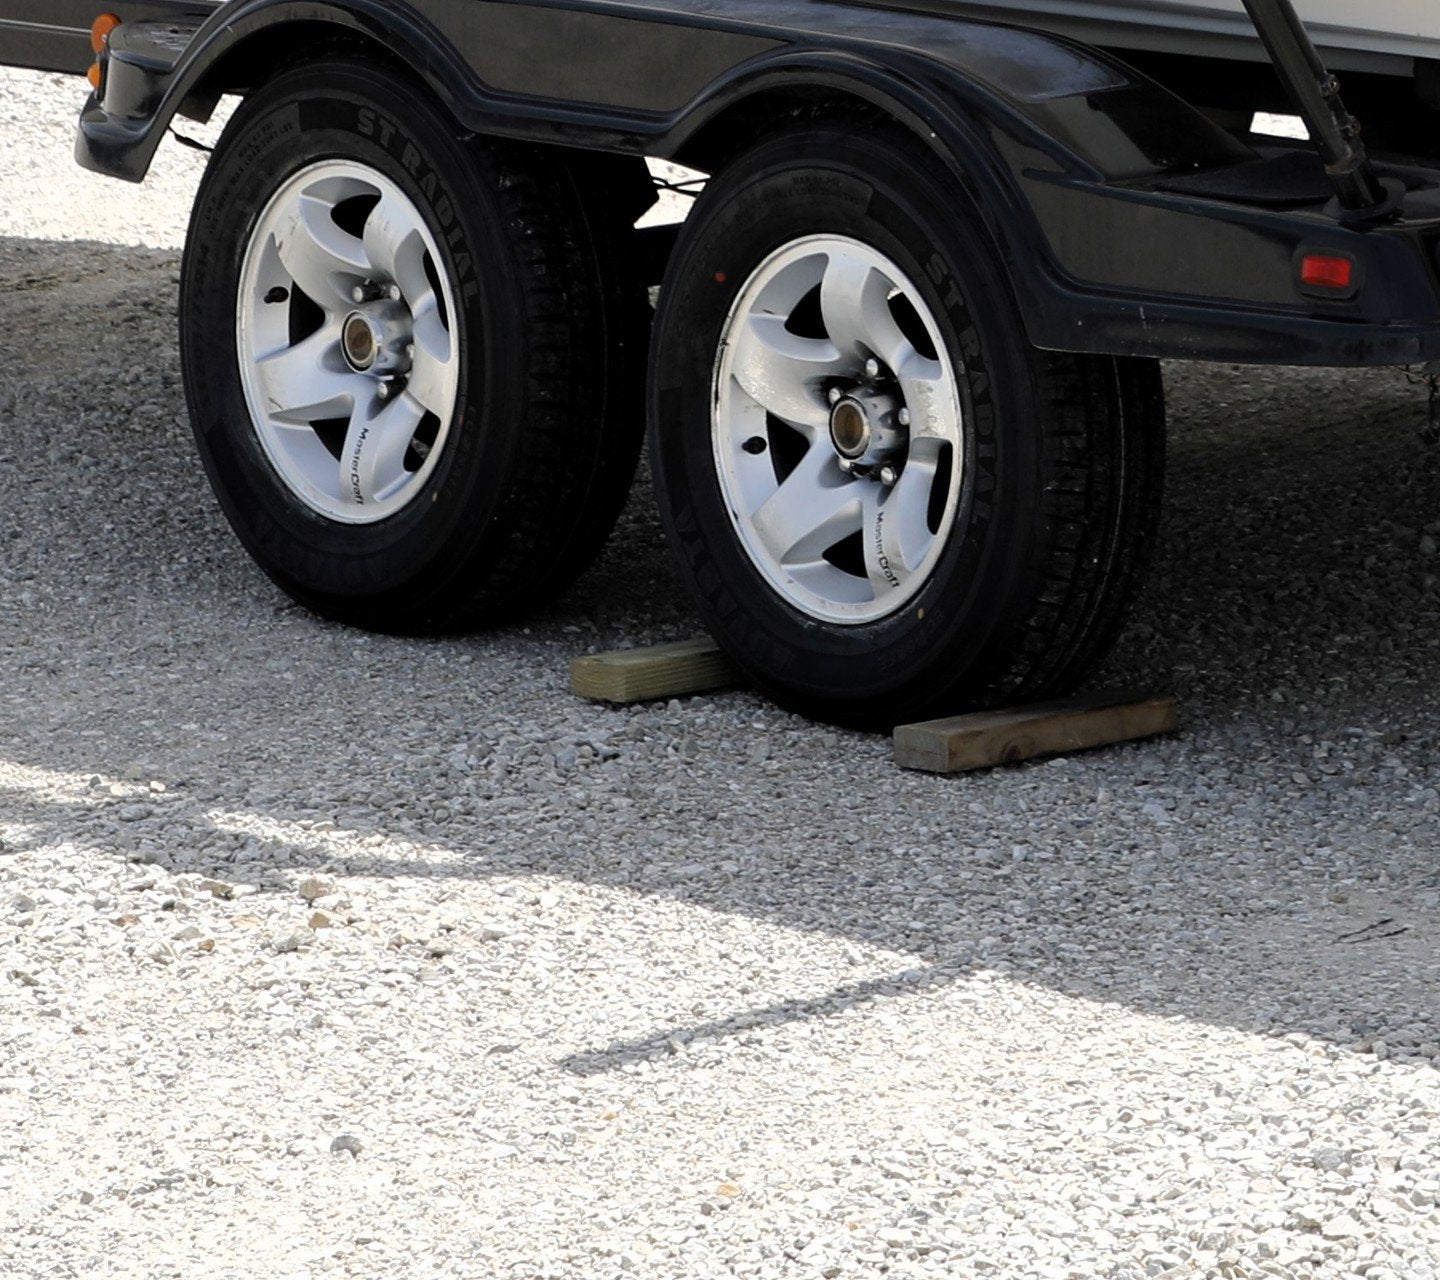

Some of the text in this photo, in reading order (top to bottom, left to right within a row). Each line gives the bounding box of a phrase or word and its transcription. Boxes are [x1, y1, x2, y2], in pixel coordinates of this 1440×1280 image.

[357, 109, 478, 305] ST RADIAL
[924, 256, 997, 526] ST RADIAL
[355, 427, 369, 505] MasterCraft
[875, 511, 899, 588] MasterCraft
